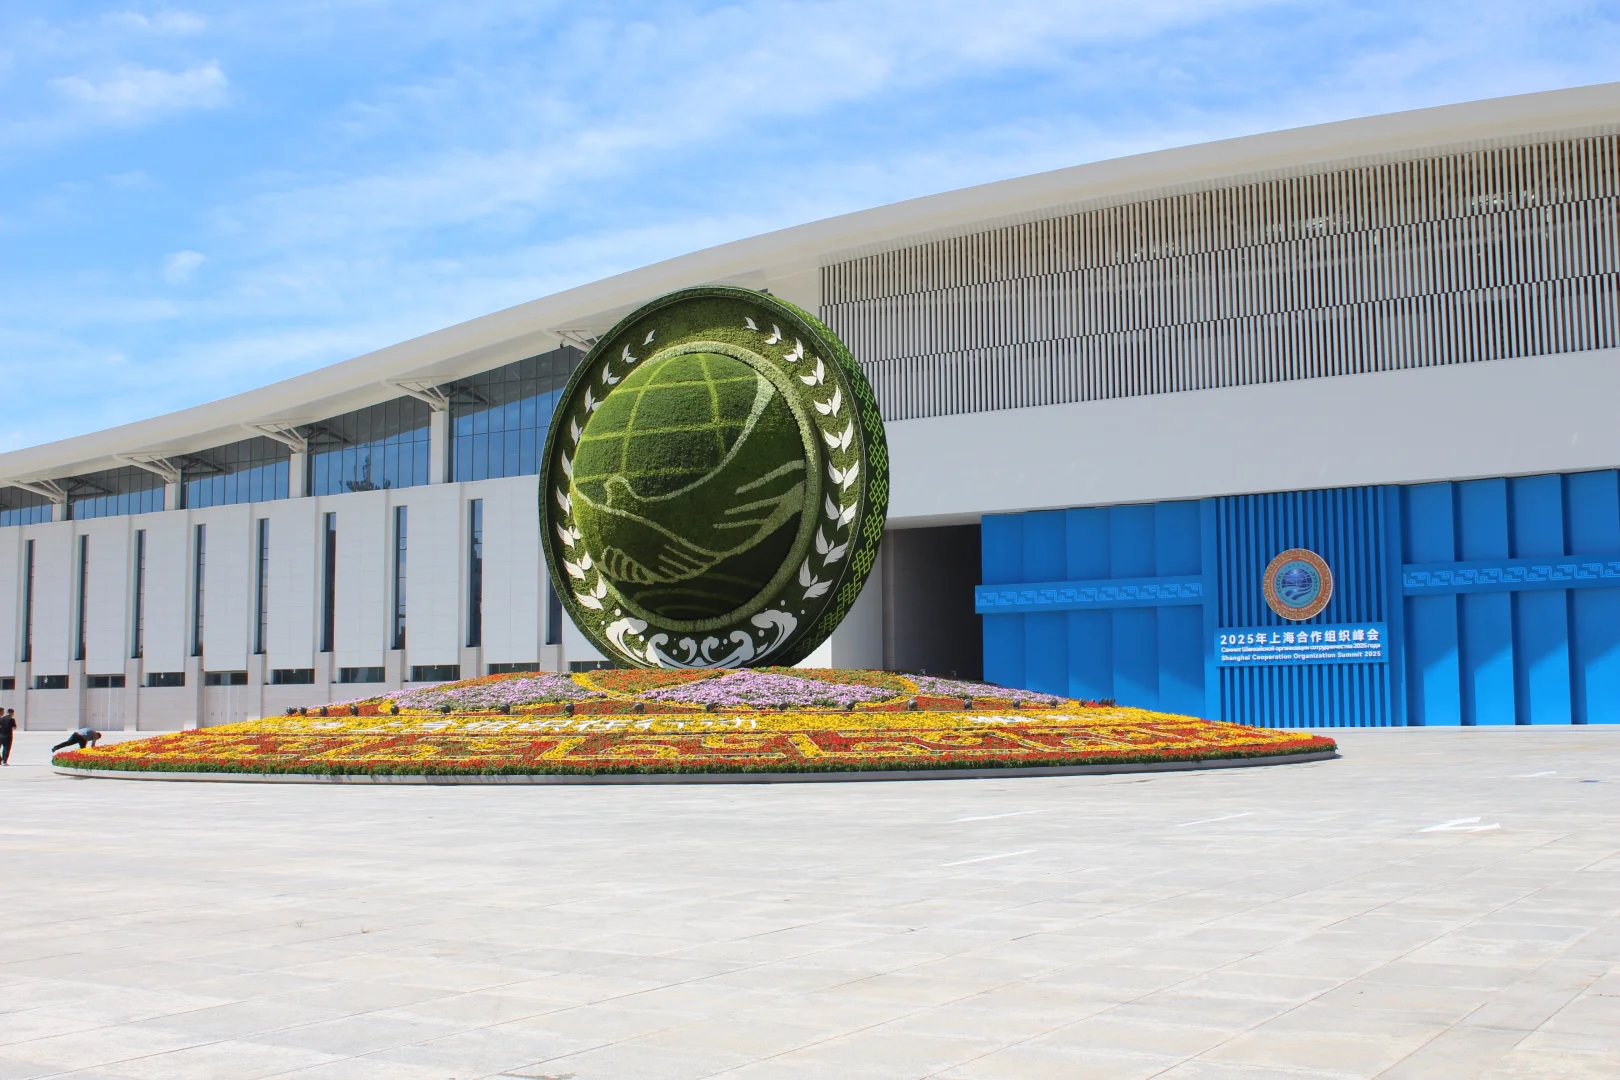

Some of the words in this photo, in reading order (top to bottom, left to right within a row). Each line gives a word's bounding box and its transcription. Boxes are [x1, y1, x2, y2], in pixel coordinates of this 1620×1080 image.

[1220, 628, 1380, 645] 2025年上海合作组织峰会
[1221, 654, 1250, 662] Shanghai
[1252, 653, 1292, 661] Cooperation
[1293, 652, 1336, 660] Organization
